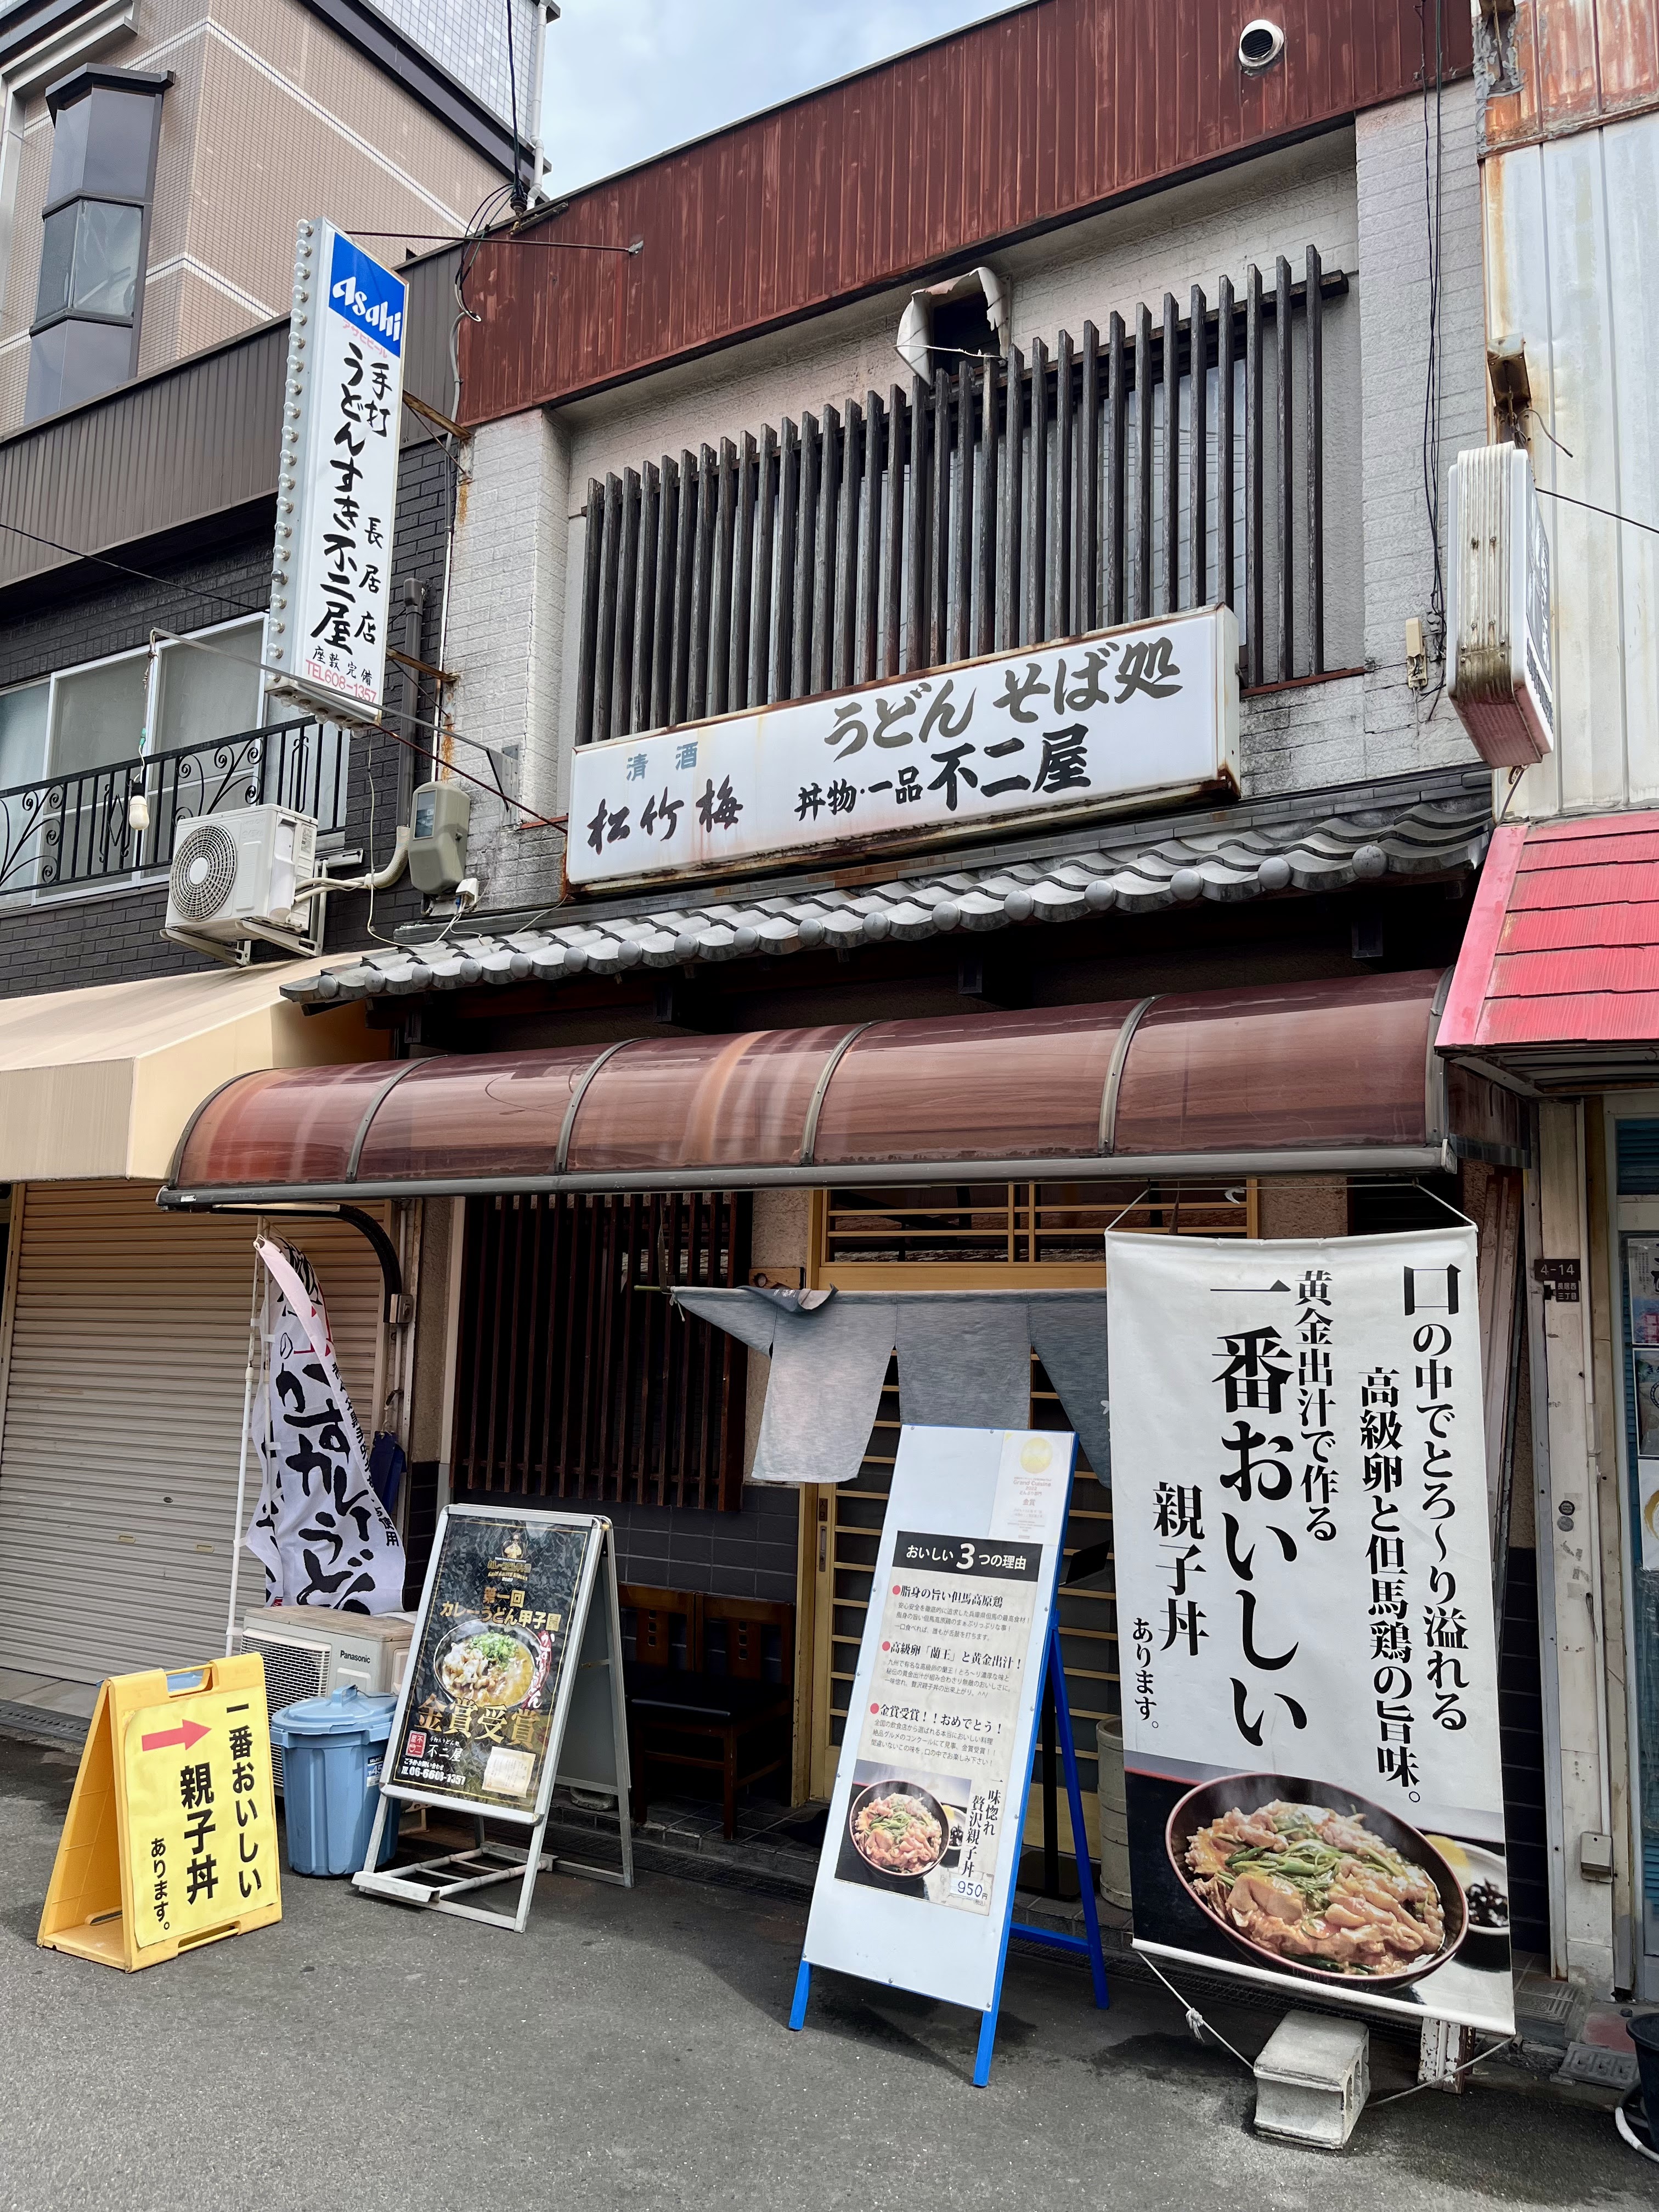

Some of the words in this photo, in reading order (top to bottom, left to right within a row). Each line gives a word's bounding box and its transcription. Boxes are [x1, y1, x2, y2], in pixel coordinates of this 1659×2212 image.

[332, 276, 402, 342] Asahi
[342, 319, 387, 359] アサヒビール
[364, 362, 392, 437] 手打
[359, 517, 384, 646] 長居店
[312, 645, 373, 686] 座敷完備
[825, 681, 977, 762] うどん
[992, 636, 1183, 724] そば処
[626, 741, 698, 781] 清酒
[928, 724, 1091, 811] 不二屋
[586, 774, 744, 854] 松竹梅
[1540, 1264, 1575, 1276] 4-14
[1558, 1292, 1577, 1300] 三丁目
[1294, 1269, 1340, 1541] 黄金出汁で作る
[1210, 1279, 1308, 1746] 一番おいしい
[483, 1585, 526, 1608] 第一回
[1152, 1481, 1210, 1656] 親子丼
[1358, 1366, 1421, 1804] 高級卵と但馬鶏の旨味。
[439, 1600, 562, 1632] カレーうどん甲子園
[340, 1650, 370, 1664] Panasonic
[1132, 1617, 1159, 1729] あります。
[415, 1693, 540, 1750] 金賞受賞
[427, 1745, 463, 1762] 不二屋
[179, 1762, 219, 1905] 親子丼
[226, 1703, 262, 1899] 一番おいしい
[150, 1837, 170, 1931] あります。
